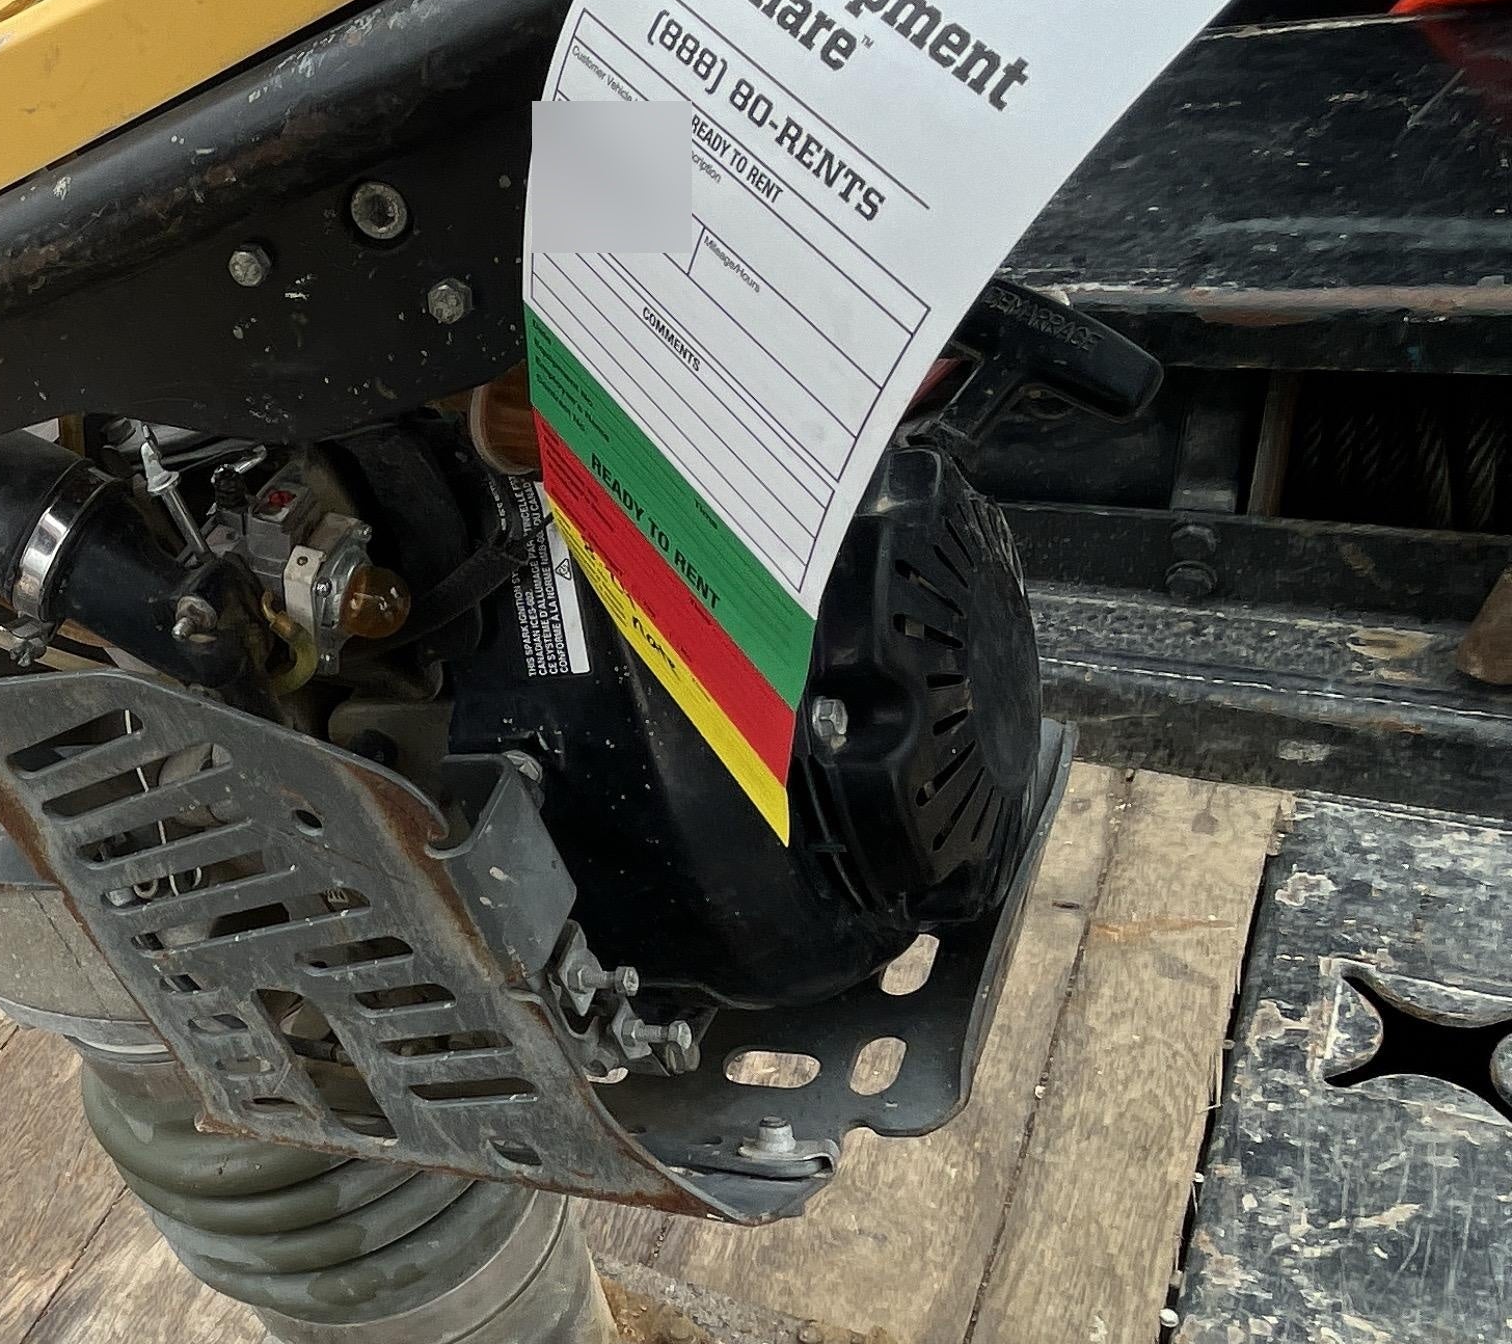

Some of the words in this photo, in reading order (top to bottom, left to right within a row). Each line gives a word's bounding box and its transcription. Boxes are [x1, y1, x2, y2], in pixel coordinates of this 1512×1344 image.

[571, 45, 605, 81] Customer
[647, 9, 728, 94] (888)
[729, 77, 886, 221] 80-RENTS
[691, 114, 731, 155] READY
[730, 148, 749, 174] TO
[746, 167, 784, 204] RENT
[642, 306, 701, 372] COMMENTS
[591, 452, 645, 521] READY
[647, 518, 671, 552] TO
[674, 546, 720, 609] RENT
[520, 625, 533, 656] SPARK
[532, 630, 548, 676] CANADIAN
[551, 622, 569, 674] CONFORME
[548, 662, 559, 675] CE
